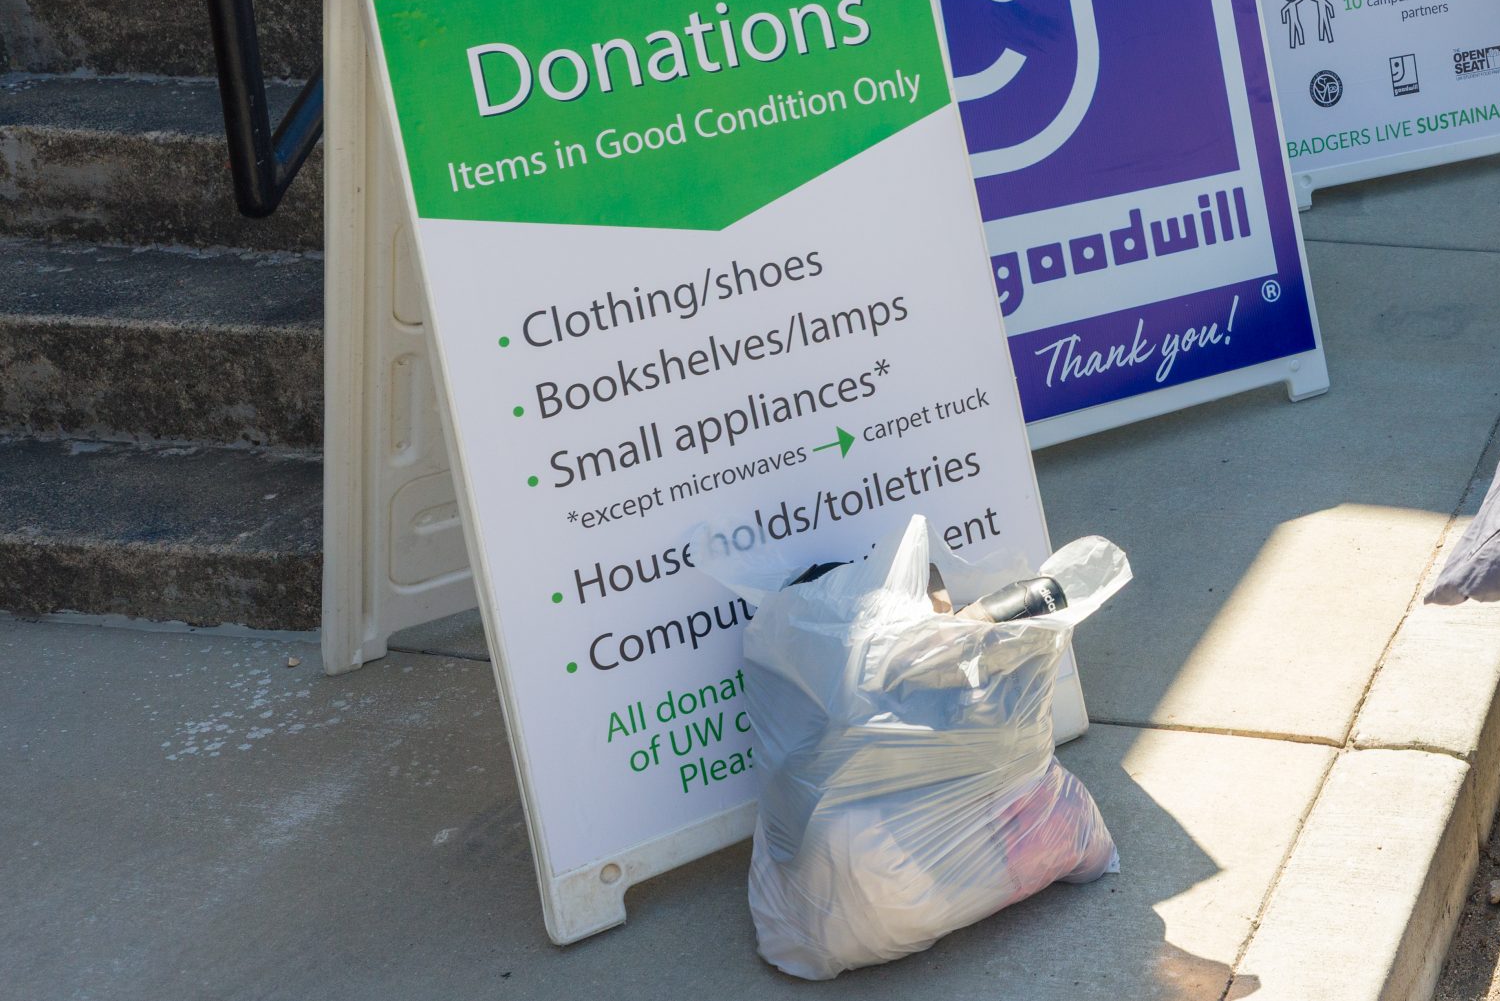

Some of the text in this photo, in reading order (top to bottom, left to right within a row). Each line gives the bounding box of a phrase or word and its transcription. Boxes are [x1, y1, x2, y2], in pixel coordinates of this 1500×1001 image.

[1401, 2, 1449, 22] partners
[1453, 48, 1486, 63] OPEN
[1454, 59, 1486, 74] SEAT
[447, 69, 922, 193] Items in Good Condition Only
[1287, 128, 1371, 158] BADGERS
[1375, 120, 1412, 142] LIVE
[522, 248, 824, 348] Clothing/shoes
[535, 291, 909, 420] Bookshelves/lamps
[1034, 294, 1240, 388] Thank you!
[550, 423, 663, 489] Small
[669, 446, 808, 504] microwaves
[862, 410, 930, 445] carpet
[935, 386, 990, 422] truck
[606, 701, 646, 744] All
[629, 731, 664, 772] of
[668, 712, 724, 758] UW
